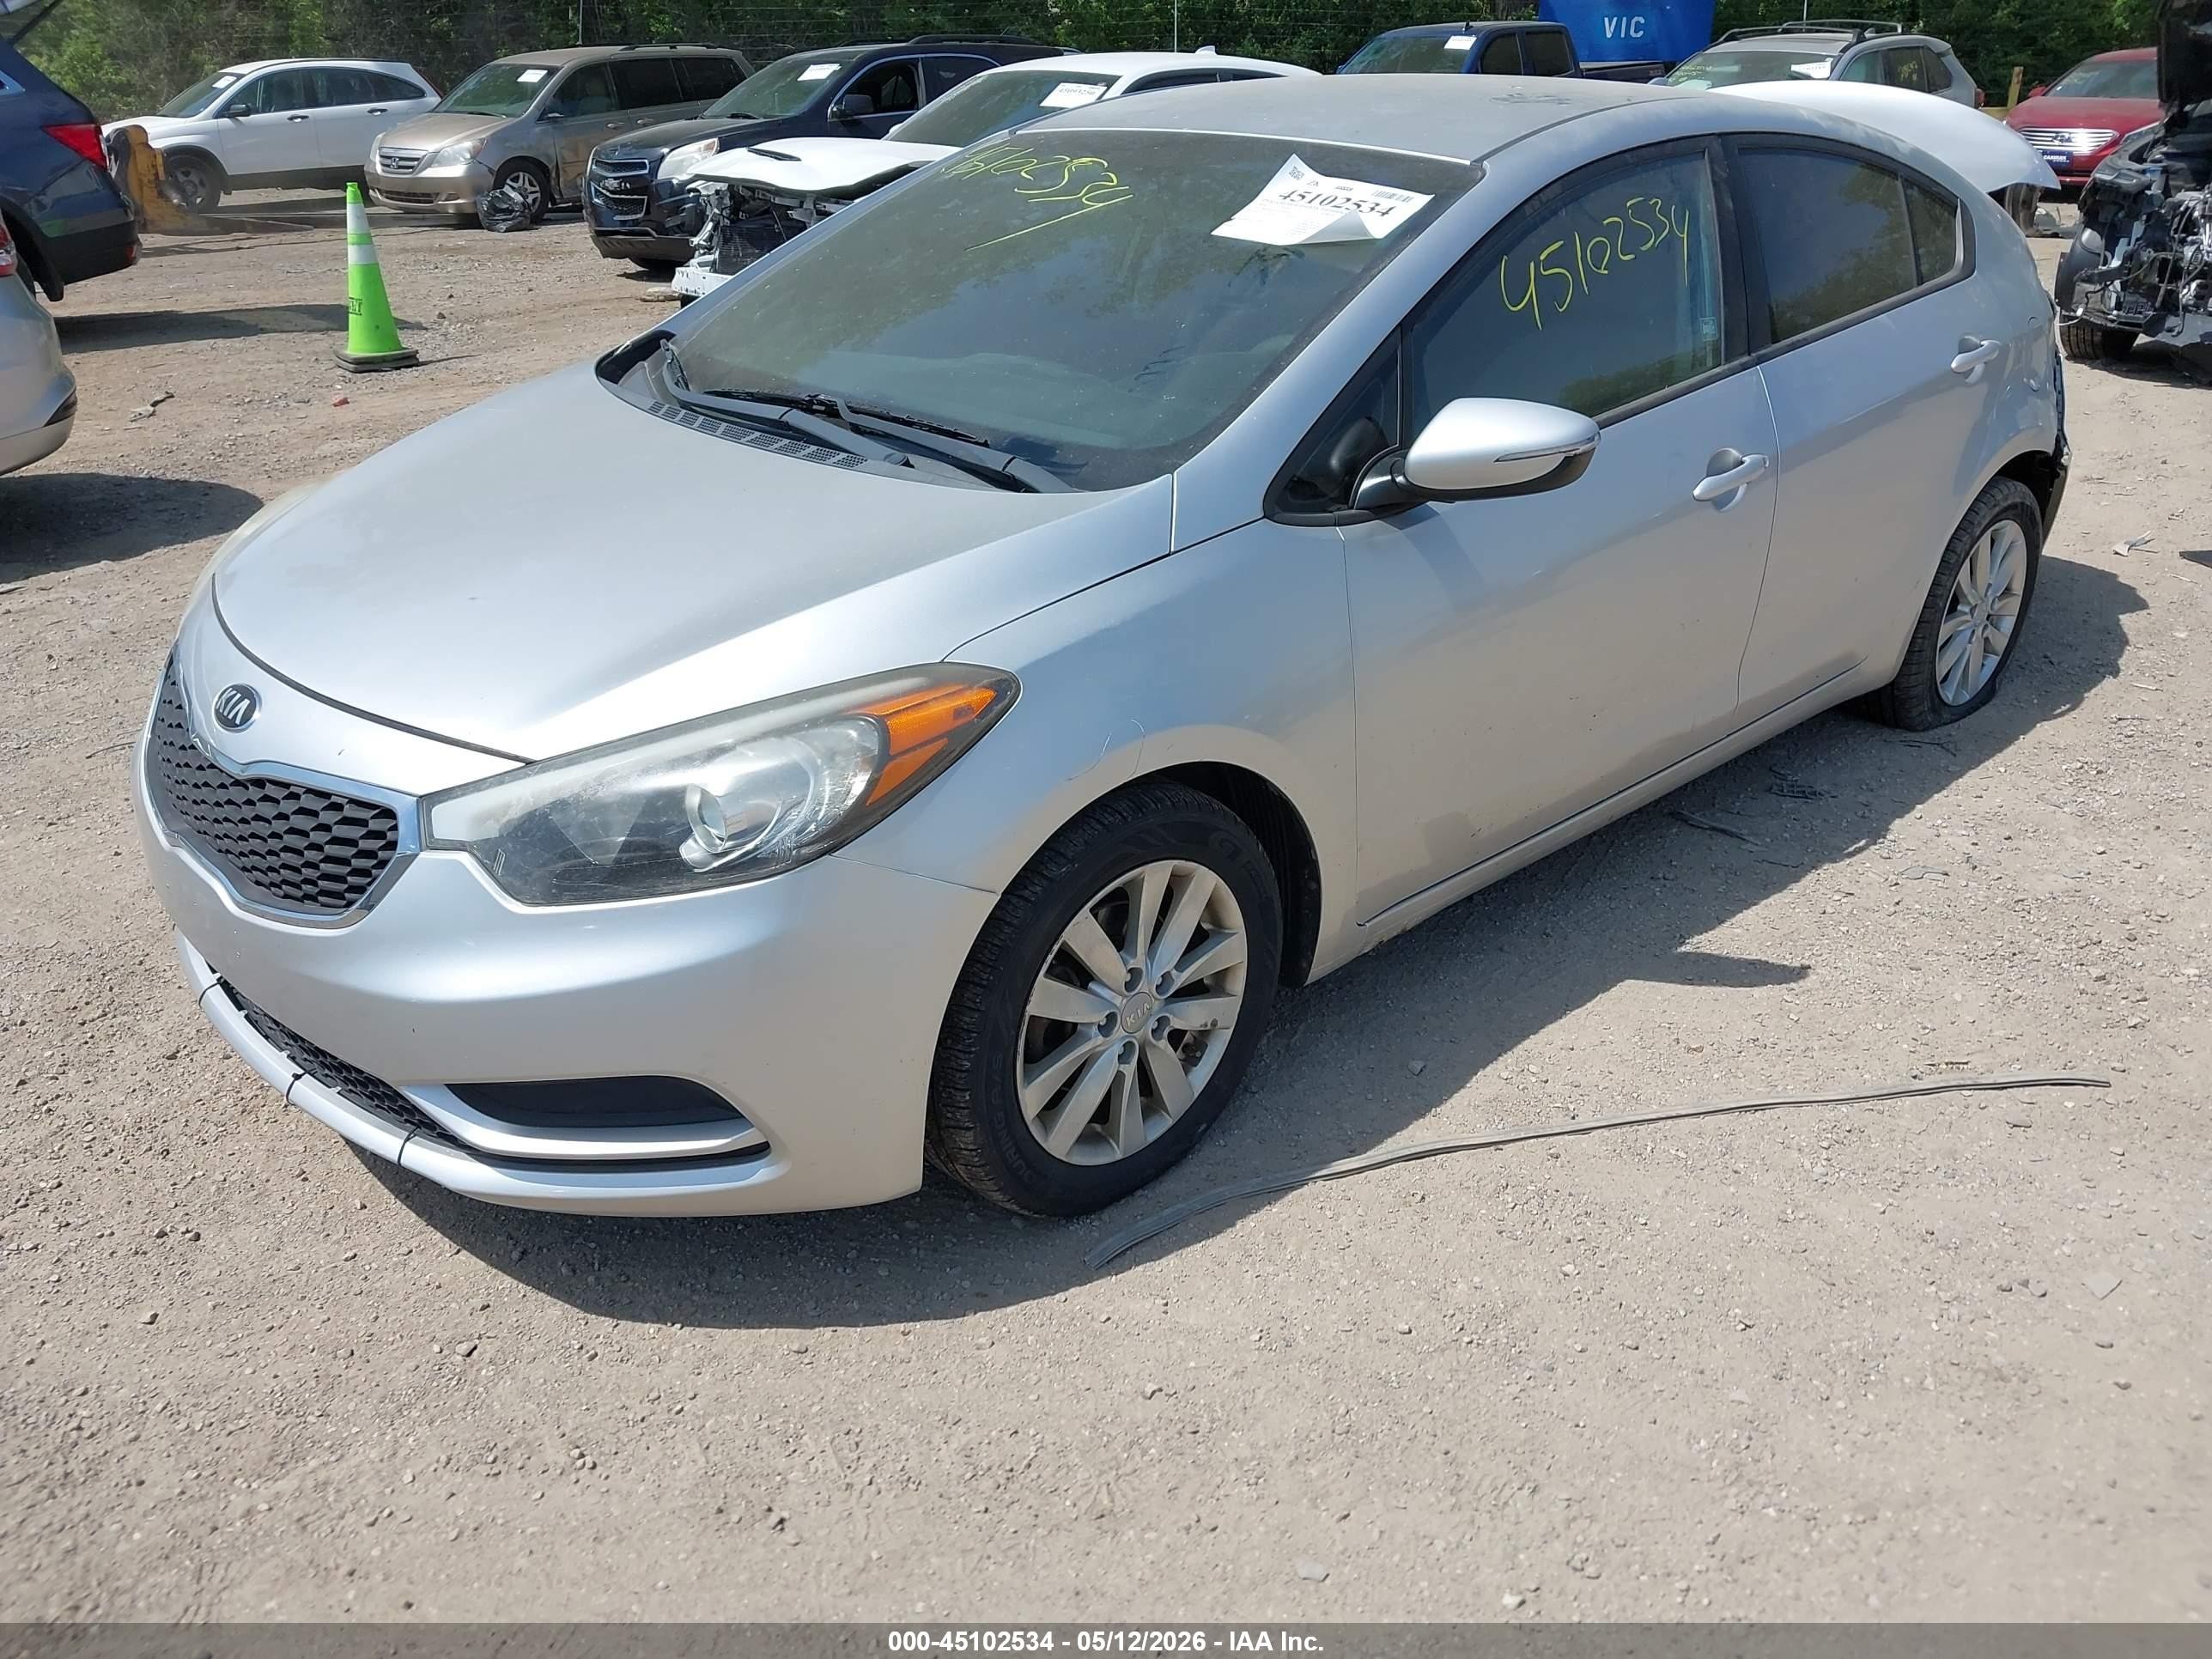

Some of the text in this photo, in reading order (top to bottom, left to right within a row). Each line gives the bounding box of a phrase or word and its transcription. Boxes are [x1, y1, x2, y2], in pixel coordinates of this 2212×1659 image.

[1603, 15, 1645, 39] VIC
[1278, 189, 1398, 218] 45102534
[1500, 197, 1690, 331] 45102534
[1125, 1001, 1151, 1029] KIA
